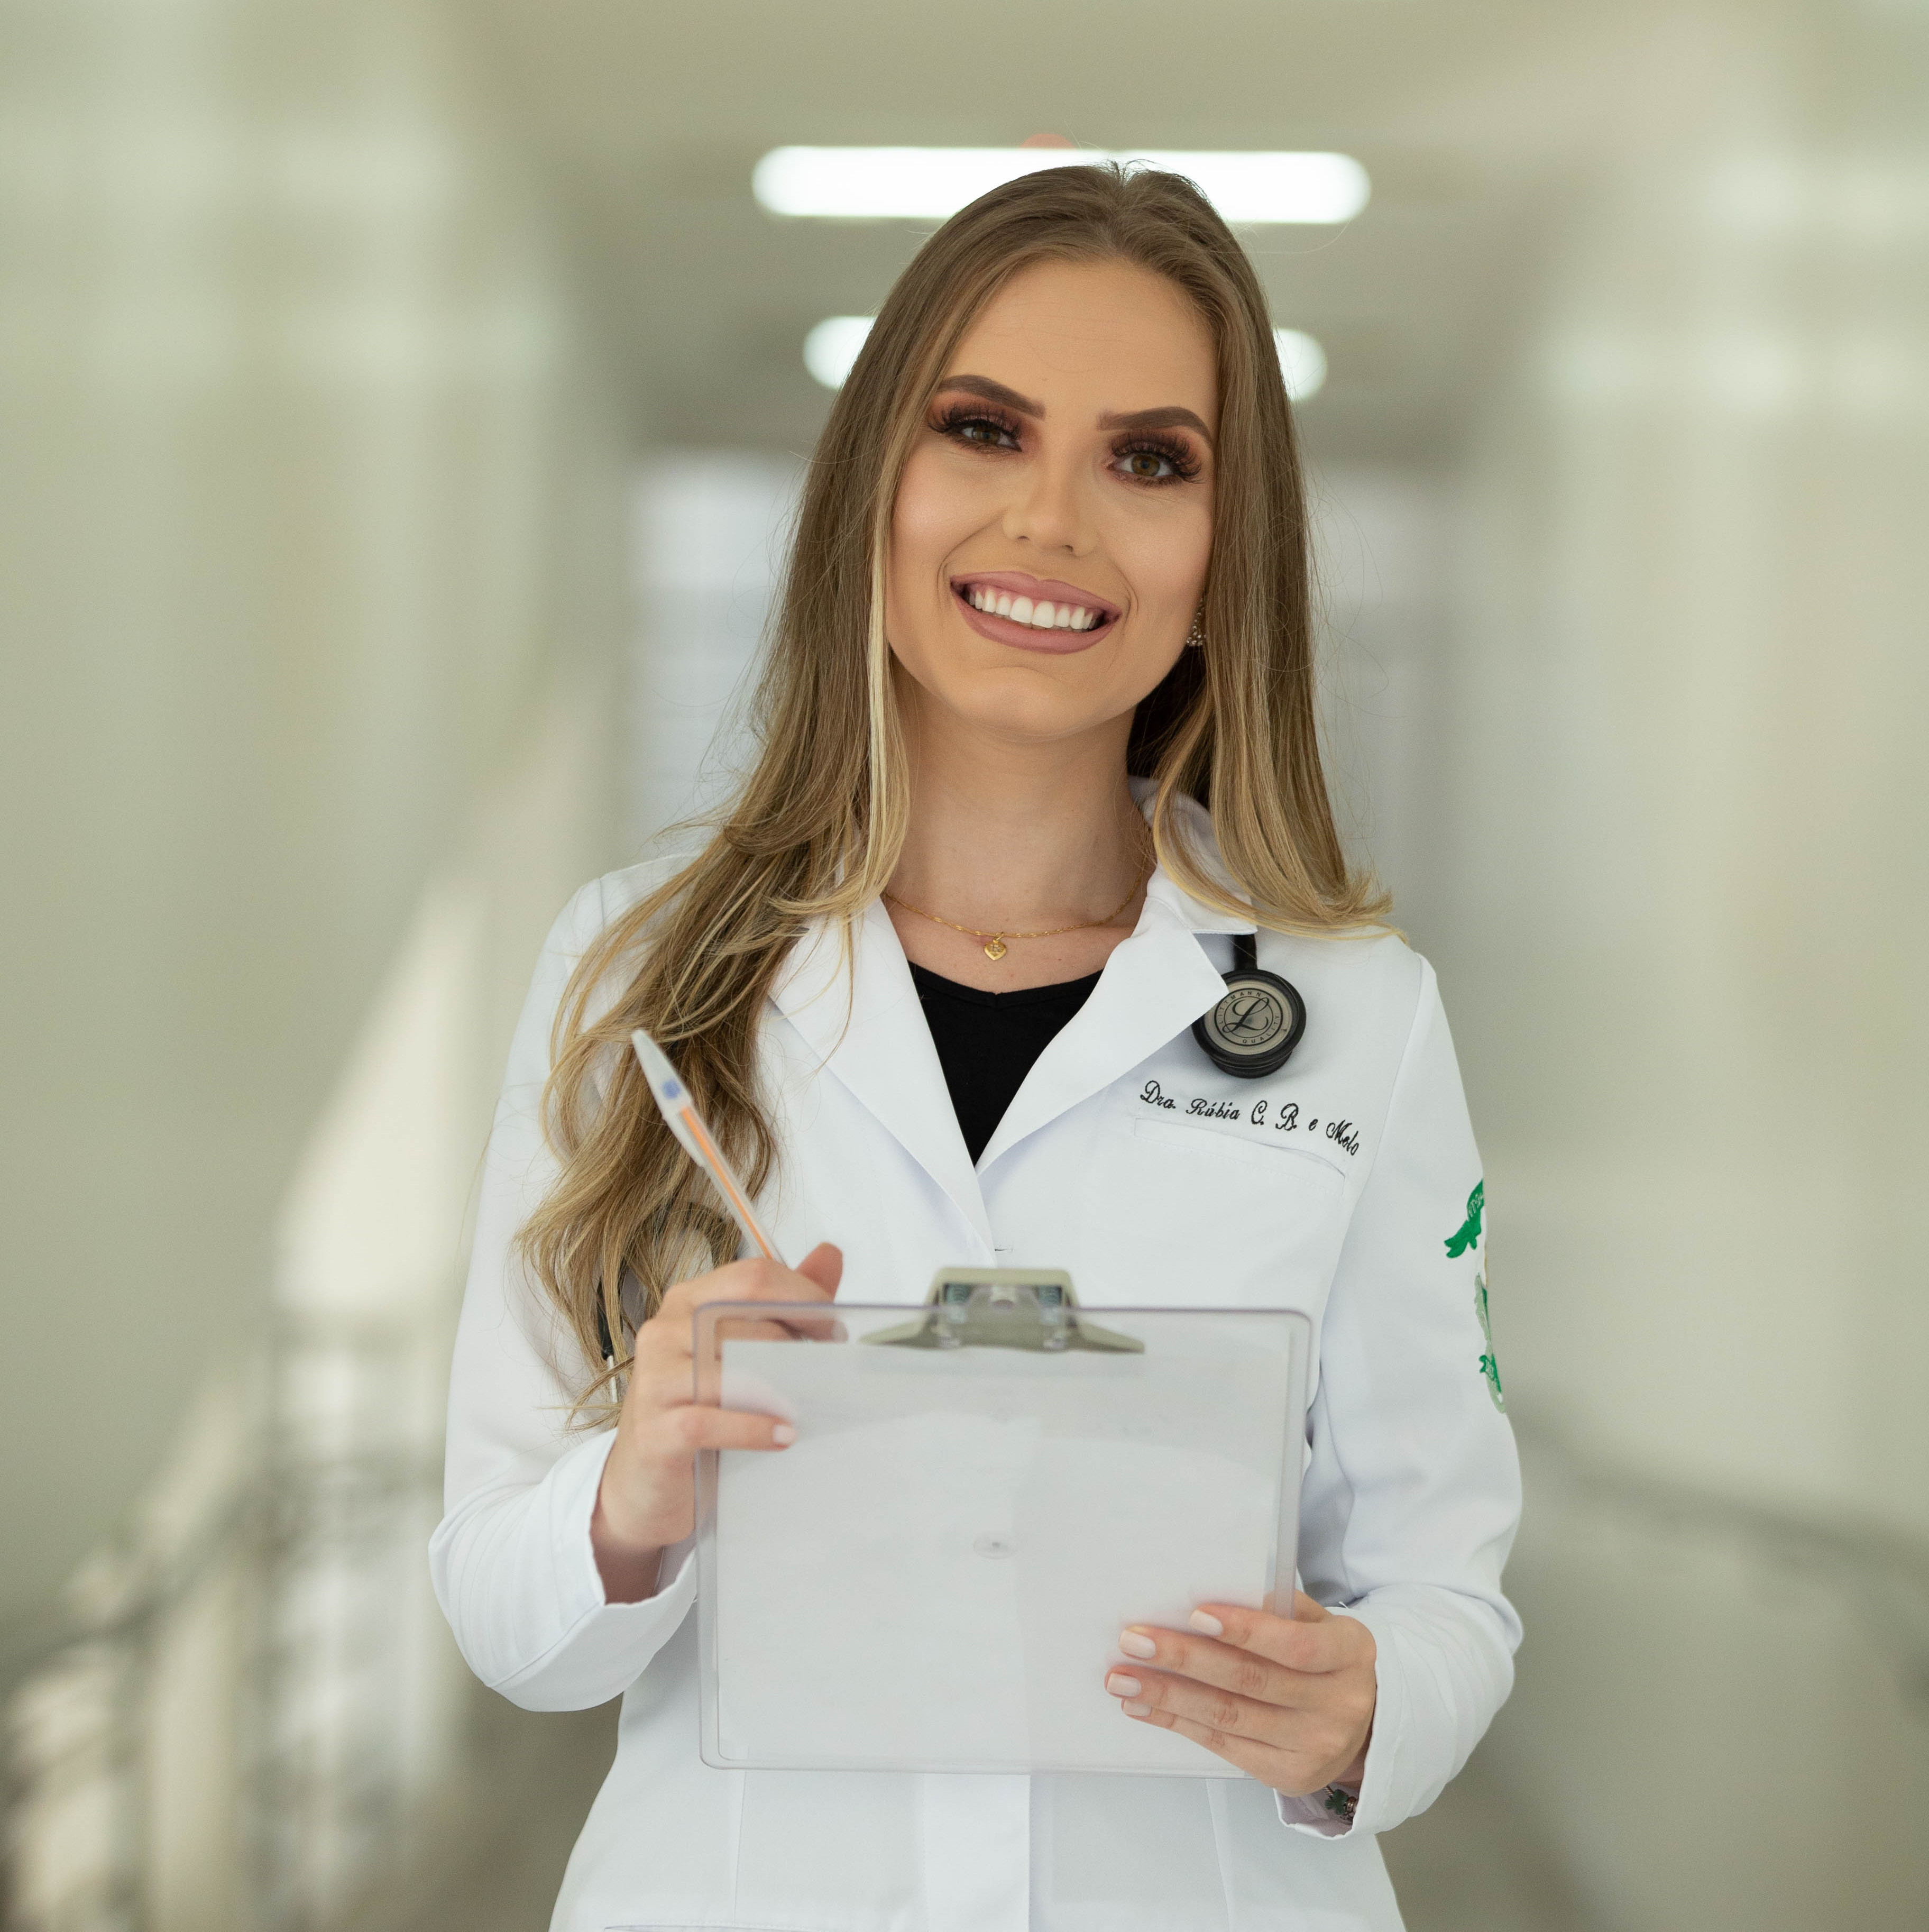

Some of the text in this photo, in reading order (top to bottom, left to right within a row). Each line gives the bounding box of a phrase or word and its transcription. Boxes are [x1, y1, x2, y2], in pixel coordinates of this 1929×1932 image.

[1218, 991, 1261, 1024] LITTMANN
[1243, 1015, 1280, 1043] QUALITY
[1140, 1080, 1176, 1109] Dra.
[1186, 1098, 1241, 1120] Rúbia
[1251, 1100, 1267, 1125] C.
[1275, 1103, 1299, 1131] B.
[1308, 1119, 1318, 1131] e
